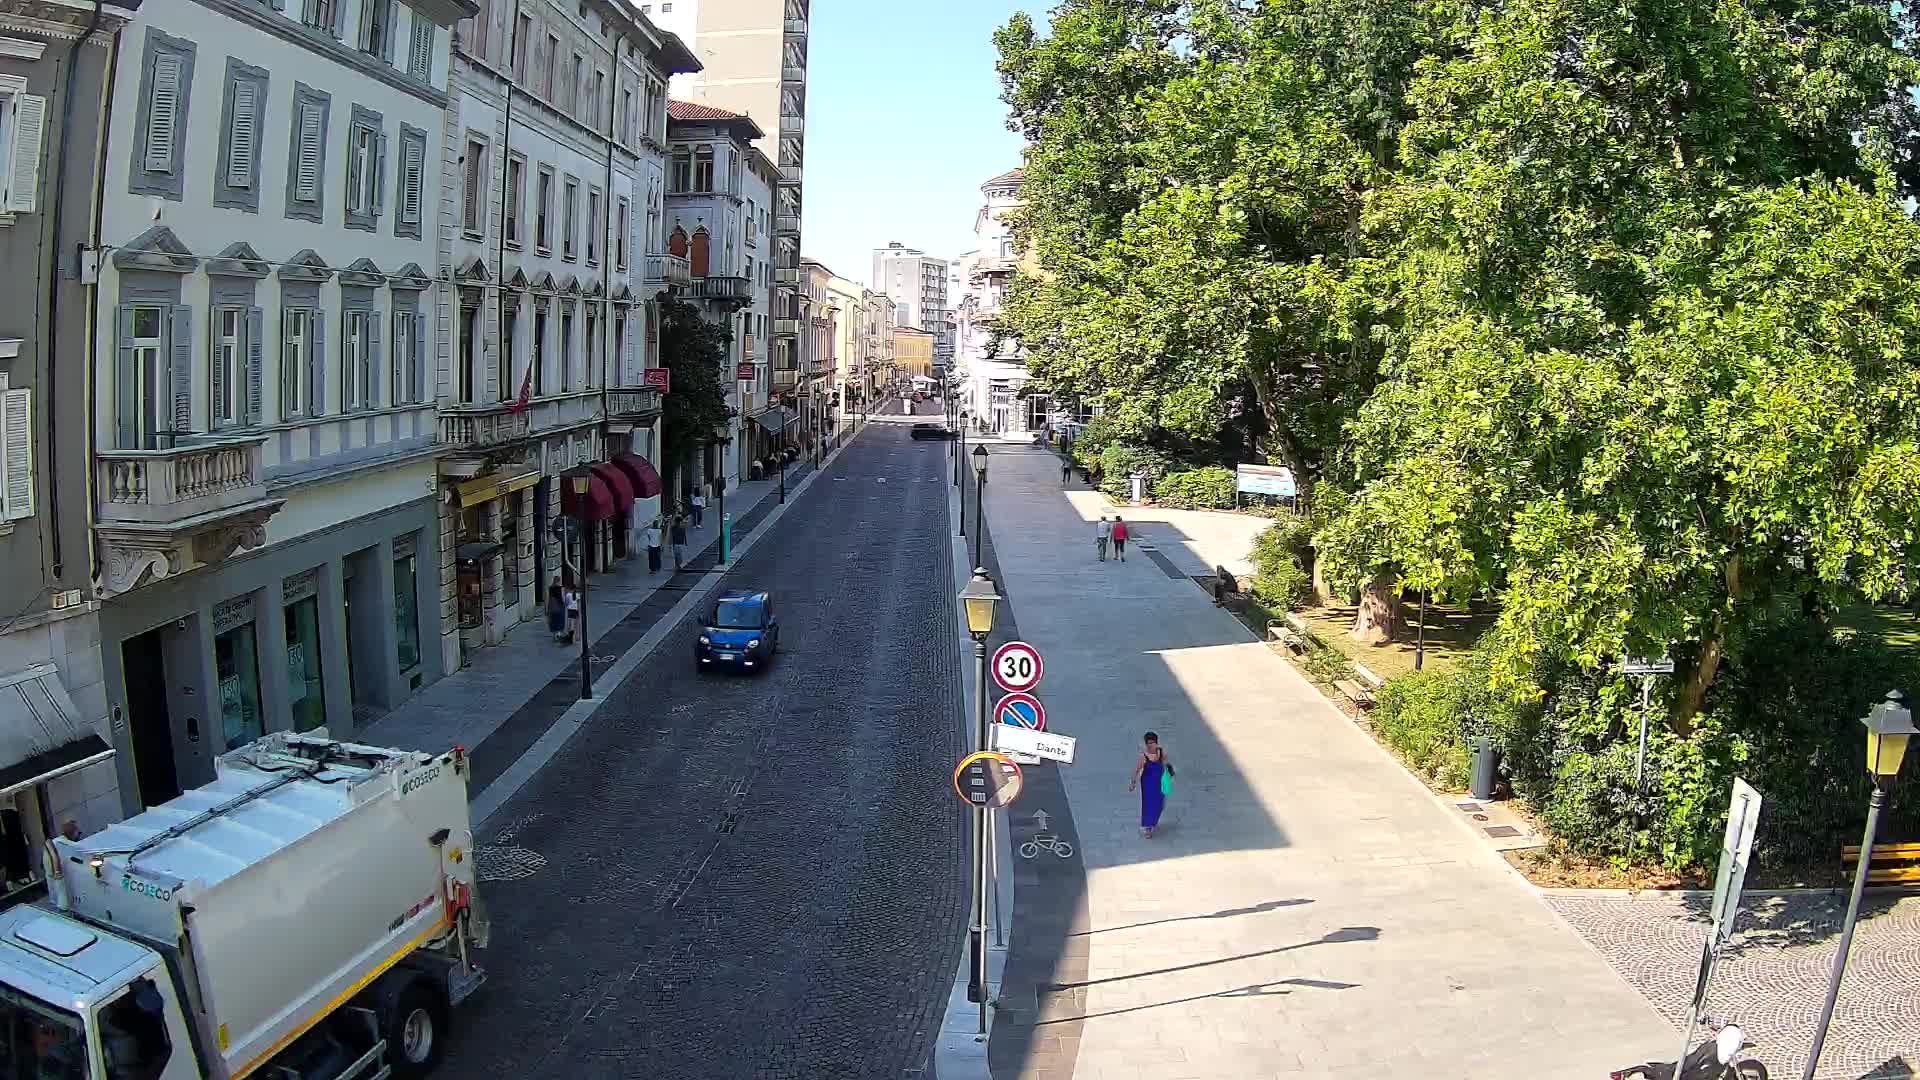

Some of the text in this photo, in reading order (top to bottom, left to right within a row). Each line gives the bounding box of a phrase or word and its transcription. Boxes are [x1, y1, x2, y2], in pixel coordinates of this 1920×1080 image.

[1004, 656, 1031, 678] 30
[1036, 741, 1067, 756] Dante
[130, 880, 170, 902] COSECO
